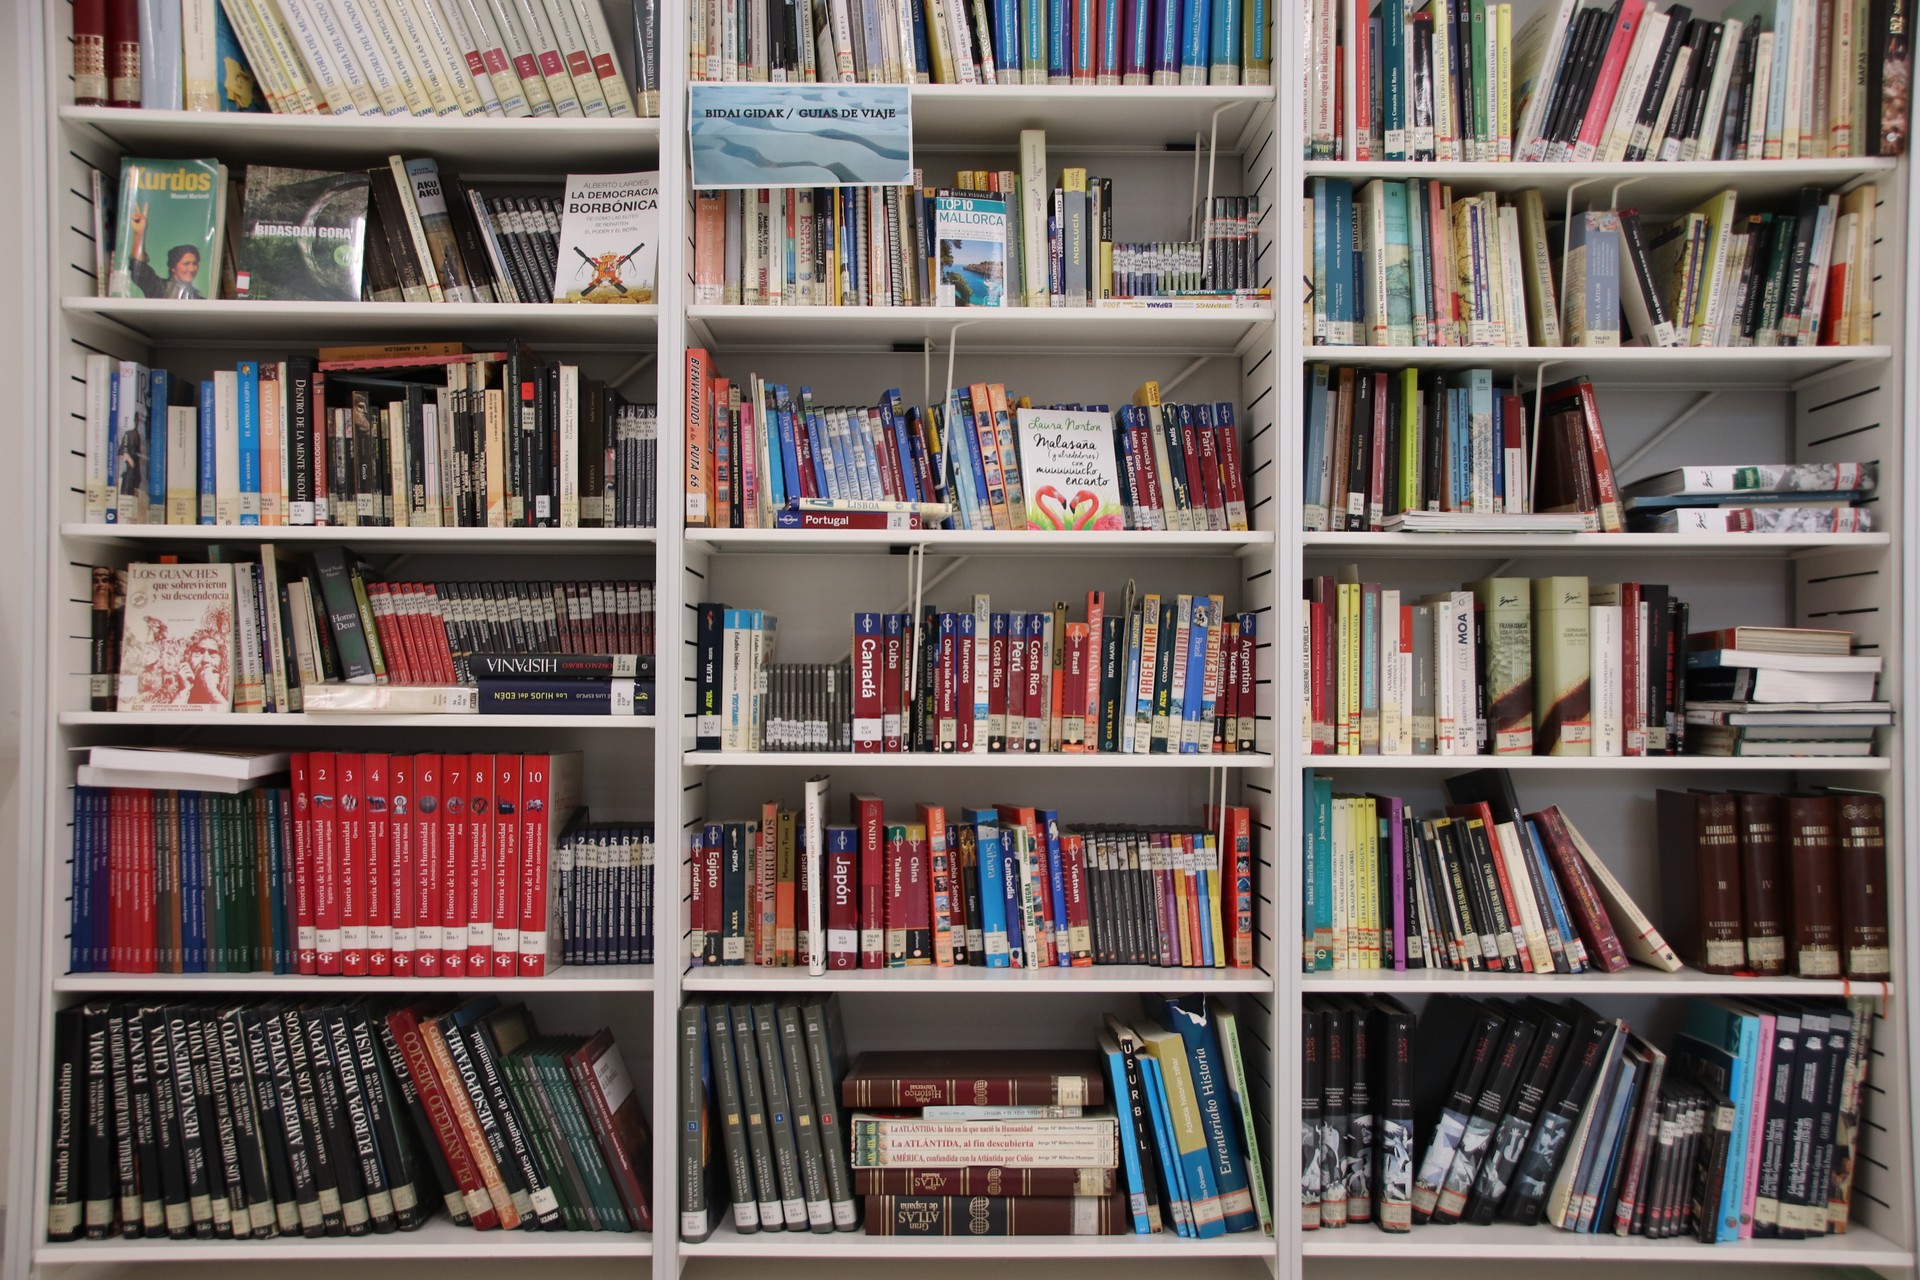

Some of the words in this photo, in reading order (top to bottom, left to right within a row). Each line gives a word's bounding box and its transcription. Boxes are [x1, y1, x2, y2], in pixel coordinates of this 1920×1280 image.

[706, 109, 740, 118] BIDAI
[744, 109, 783, 118] GIDAK
[787, 109, 793, 119] /
[800, 108, 838, 118] GUIAS
[842, 109, 858, 118] DE
[861, 108, 896, 118] VIAJE
[129, 166, 211, 191] Kurdos
[417, 180, 438, 191] AKU
[418, 187, 440, 198] AKU
[588, 188, 658, 199] DEMOCRACIA
[570, 200, 658, 213] BORBÓNICA
[940, 212, 1003, 226] MALLORCA
[255, 224, 316, 238] BIDASOAN
[800, 215, 812, 264] ESPAÑA
[295, 380, 306, 415] DENTRO
[689, 358, 700, 427] BIENVENIDOS
[296, 417, 305, 427] DE
[296, 429, 305, 440] LA
[1028, 417, 1062, 430] Laura
[1065, 418, 1102, 431] Norton
[1033, 433, 1096, 450] Malasaña
[1184, 430, 1193, 456] Croacia
[1202, 431, 1210, 457] París
[296, 442, 305, 471] MENTE
[690, 444, 700, 471] RUTA
[690, 474, 699, 488] 66
[1066, 474, 1110, 486] encanto
[1126, 455, 1138, 507] BARCELONA
[1140, 432, 1148, 462] Florencia
[1147, 478, 1158, 509] Toscana
[847, 501, 880, 510] LISBOA
[805, 515, 849, 526] Portugal
[132, 569, 156, 579] LOS
[158, 568, 218, 579] GUANCHES
[153, 581, 168, 590] que
[170, 580, 227, 590] sobrevivieron
[153, 592, 157, 602] y
[161, 592, 172, 600] su
[173, 591, 230, 600] descendencia
[332, 612, 356, 624] Homo
[336, 620, 356, 631] Deus
[1459, 613, 1467, 644] MOA
[487, 658, 558, 672] HISPANIA
[889, 640, 899, 669] Cuba
[962, 640, 970, 684] Marruecos
[993, 640, 1002, 666] Costa
[1012, 642, 1023, 672] Perú
[1030, 640, 1040, 672] Costa
[1140, 628, 1156, 694] ARGENTINA
[1204, 629, 1220, 695] VENEZUELA
[862, 638, 876, 698] Canadá
[1217, 650, 1226, 697] Guatemala
[1242, 640, 1252, 694] Argentina
[494, 692, 515, 701] EDÉN
[299, 770, 304, 781] 1
[318, 769, 326, 780] 2
[346, 770, 352, 782] 3
[372, 771, 380, 782] 4
[397, 772, 404, 783] 5
[424, 771, 432, 782] 6
[452, 773, 459, 784] 7
[476, 772, 483, 783] 8
[503, 774, 510, 783] 9
[528, 773, 542, 782] 10
[1706, 825, 1733, 834] ORIGENES
[708, 852, 719, 888] Egipto
[765, 818, 775, 900] MARRUECOS
[986, 843, 995, 879] Sáhara
[370, 871, 376, 881] de
[524, 873, 532, 882] de
[836, 856, 850, 905] Japón
[1004, 857, 1013, 899] Cambodia
[1071, 864, 1080, 903] Vietnam
[90, 1031, 105, 1075] ROMA
[128, 1016, 148, 1084] FRANCIA
[152, 1025, 170, 1074] CHINA
[188, 1020, 204, 1060] INDIA
[222, 1022, 243, 1078] EGIPTO
[248, 1022, 270, 1075] AFRICA
[266, 1016, 290, 1077] ANTIGUA
[307, 1018, 331, 1066] JAPON
[354, 1020, 377, 1070] RUSIA
[330, 1018, 362, 1097] MEDIEVAL
[404, 1031, 434, 1091] MEXICO
[171, 1018, 199, 1139] RENACIMIENTO
[446, 1026, 496, 1130] MESOPOTAMIA
[1196, 1048, 1214, 1095] Historia
[58, 1062, 72, 1146] Precolombino
[904, 1090, 942, 1098] Histórico
[276, 1083, 303, 1145] AMERICA
[350, 1098, 373, 1155] EUROPA
[219, 1116, 238, 1162] ORIGENES
[436, 1094, 462, 1161] ANTIGUO
[504, 1112, 526, 1157] Enigmas
[1002, 1125, 1033, 1134] Humanidad
[1206, 1099, 1231, 1176] Errenteriako
[891, 1140, 901, 1148] La
[902, 1138, 962, 1149] ATLÁNTIDA,
[964, 1139, 971, 1148] al
[974, 1139, 985, 1148] fin
[987, 1139, 1034, 1148] descubierta
[892, 1152, 925, 1162] AMÉRICA,
[1004, 1155, 1014, 1163] por
[1016, 1154, 1033, 1162] Colón
[56, 1151, 69, 1197] Mundo
[226, 1164, 240, 1182] LOS
[457, 1168, 472, 1184] EL
[914, 1177, 947, 1186] ATLAS
[899, 1212, 939, 1223] ATLAS
[900, 1202, 923, 1210] España
